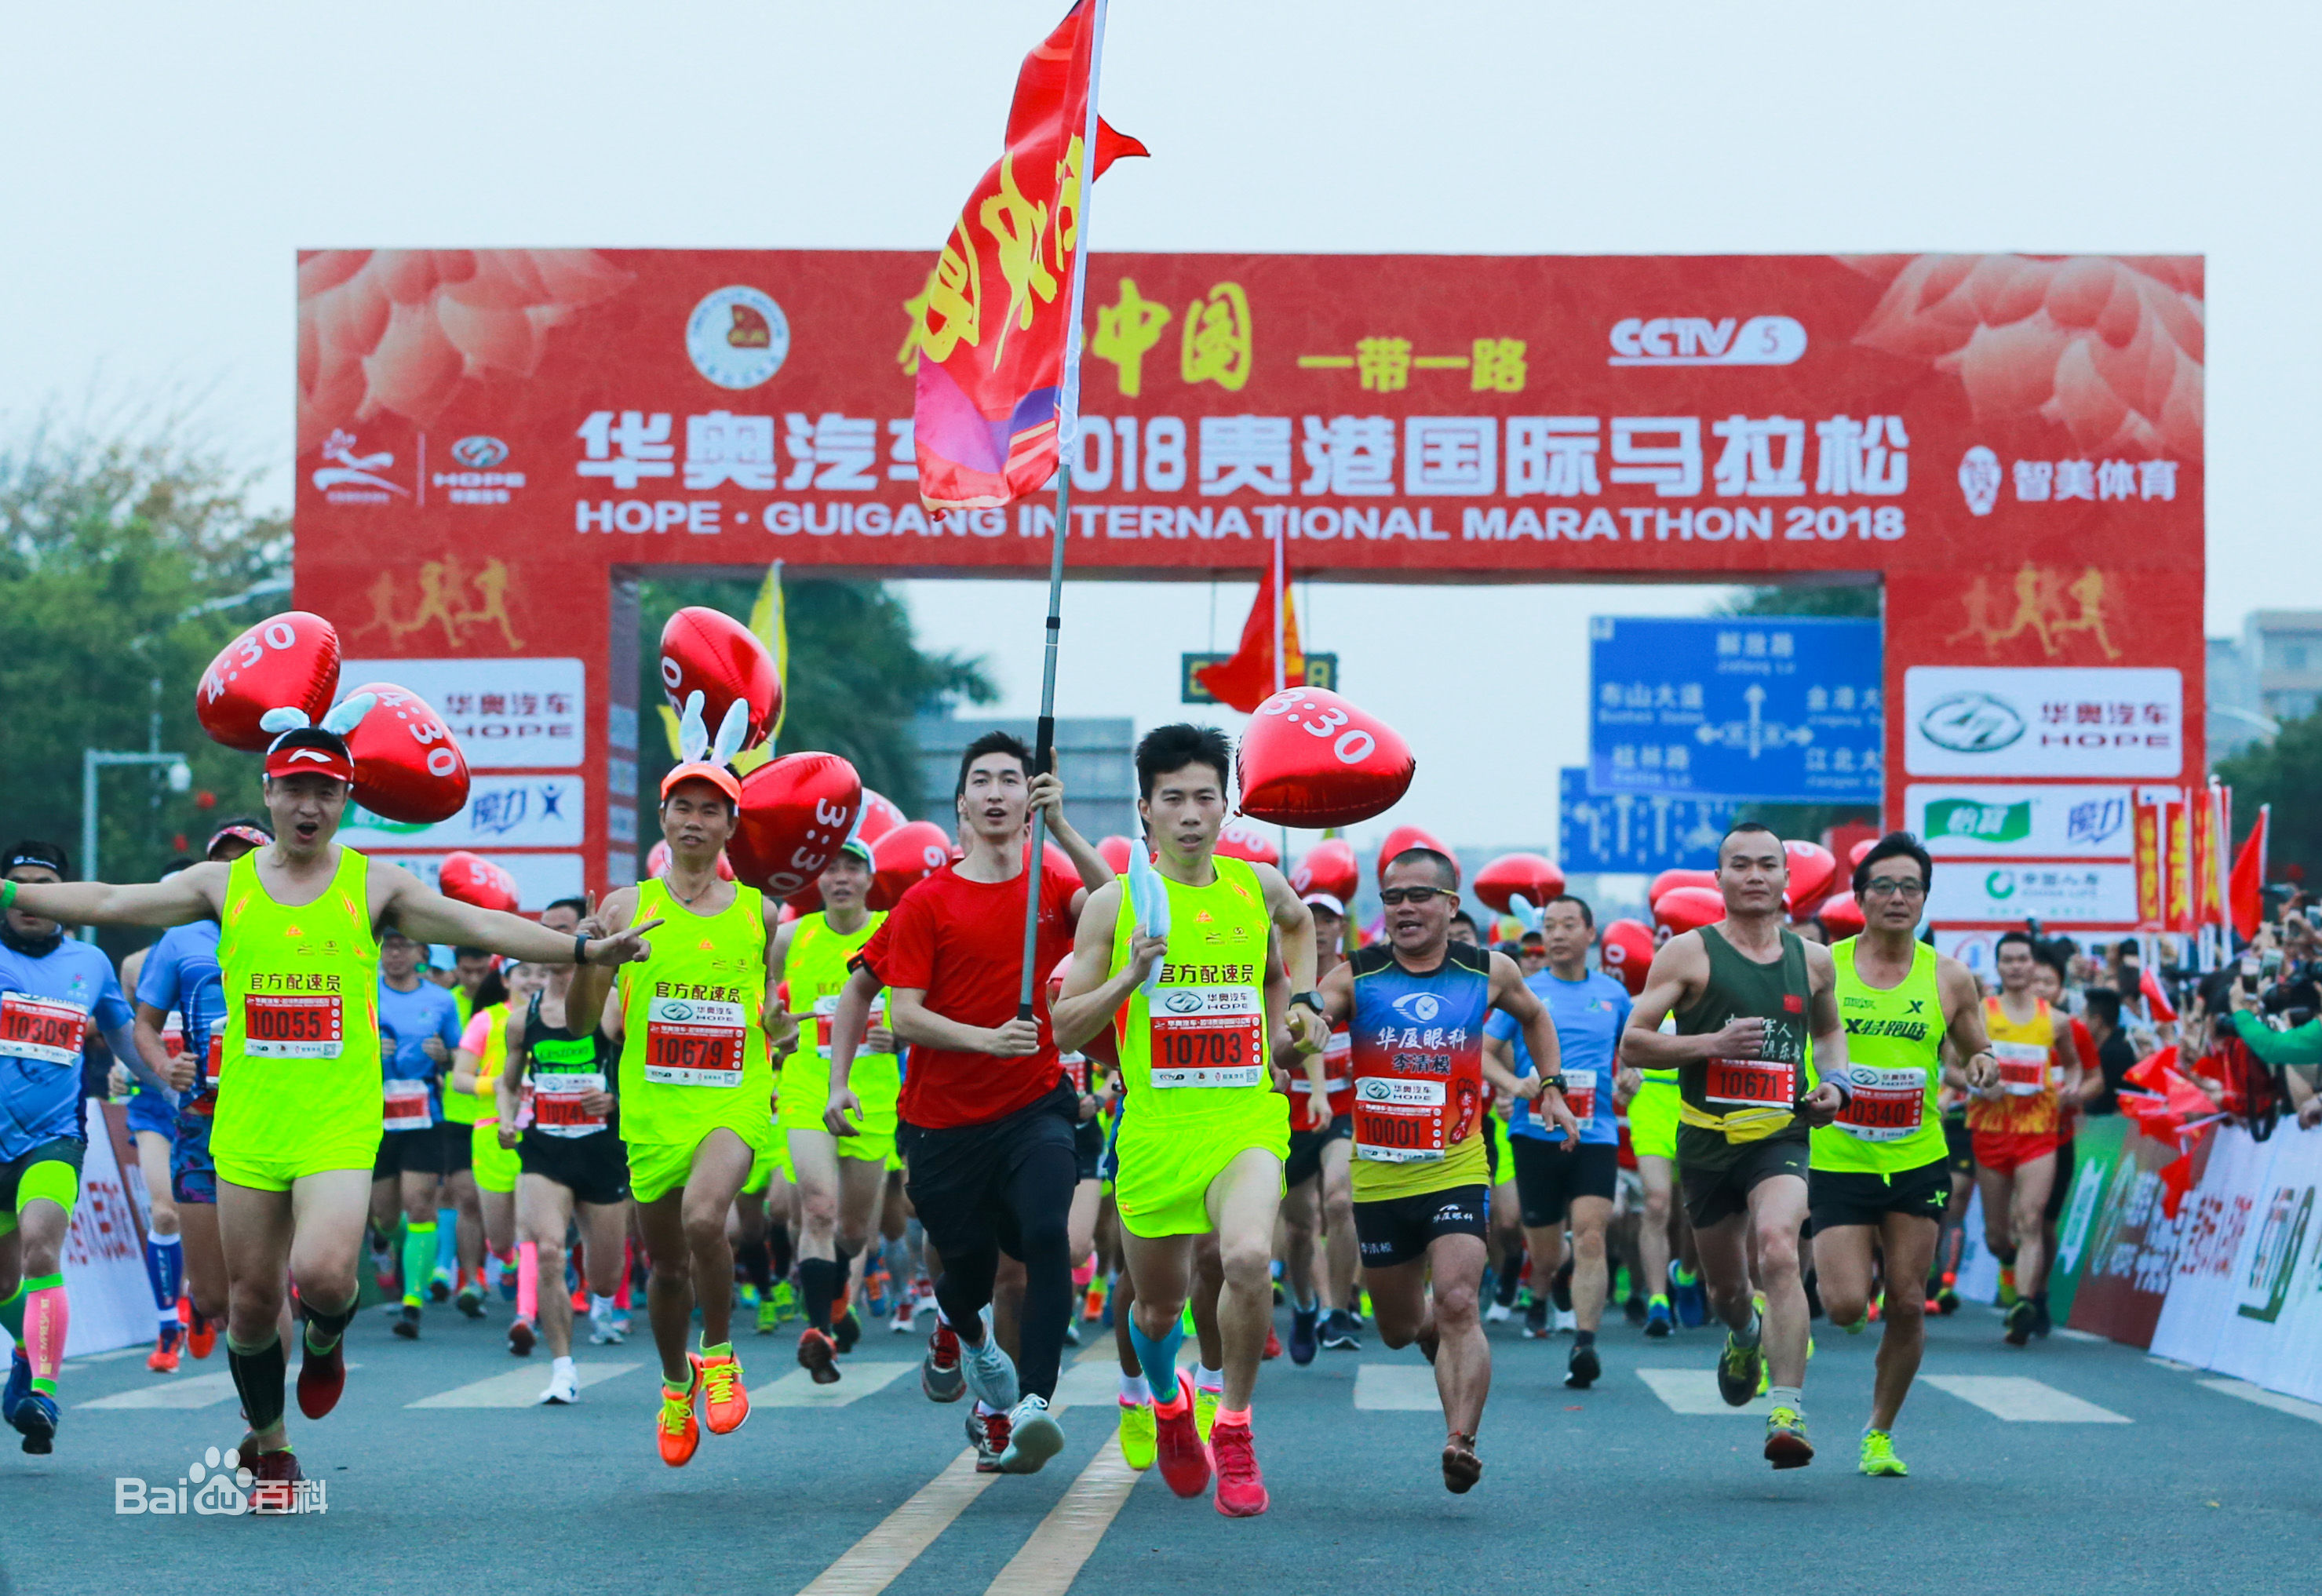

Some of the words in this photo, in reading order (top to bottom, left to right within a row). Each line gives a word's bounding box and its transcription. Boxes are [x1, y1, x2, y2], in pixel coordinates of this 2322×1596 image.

[1296, 337, 1527, 392] 一带一路
[1041, 414, 1909, 497] 018贵港国际马拉松
[2012, 458, 2179, 501] 智美体育
[575, 501, 721, 534] HOPE
[762, 501, 1008, 537] GUIGANG
[1019, 505, 1450, 541] INTERNATIONAL
[1463, 506, 1773, 541] MARATHON
[1785, 506, 1906, 541] 2018
[207, 621, 297, 705] 4:30
[1263, 688, 1376, 765] 3:30
[2042, 732, 2170, 748] HOPE
[767, 797, 847, 891] 3:30
[250, 972, 341, 993] 官方配速员
[1158, 964, 1254, 983] 官方配速员
[655, 982, 741, 1004] 官方配速员
[1207, 993, 1248, 1002] 华奥汽车
[251, 1010, 322, 1039] 10055
[696, 1005, 734, 1015] 华奥汽车
[7, 1015, 71, 1046] 10309
[1376, 1026, 1468, 1051] 华厦眼科
[655, 1037, 724, 1067] 10679
[1163, 1033, 1242, 1065] 10703
[1392, 1052, 1451, 1075] 李清模
[1394, 1084, 1432, 1095] 华奥汽车
[1719, 1070, 1778, 1099] 10671
[1844, 1099, 1906, 1125] 10340
[1363, 1117, 1420, 1146] 10001
